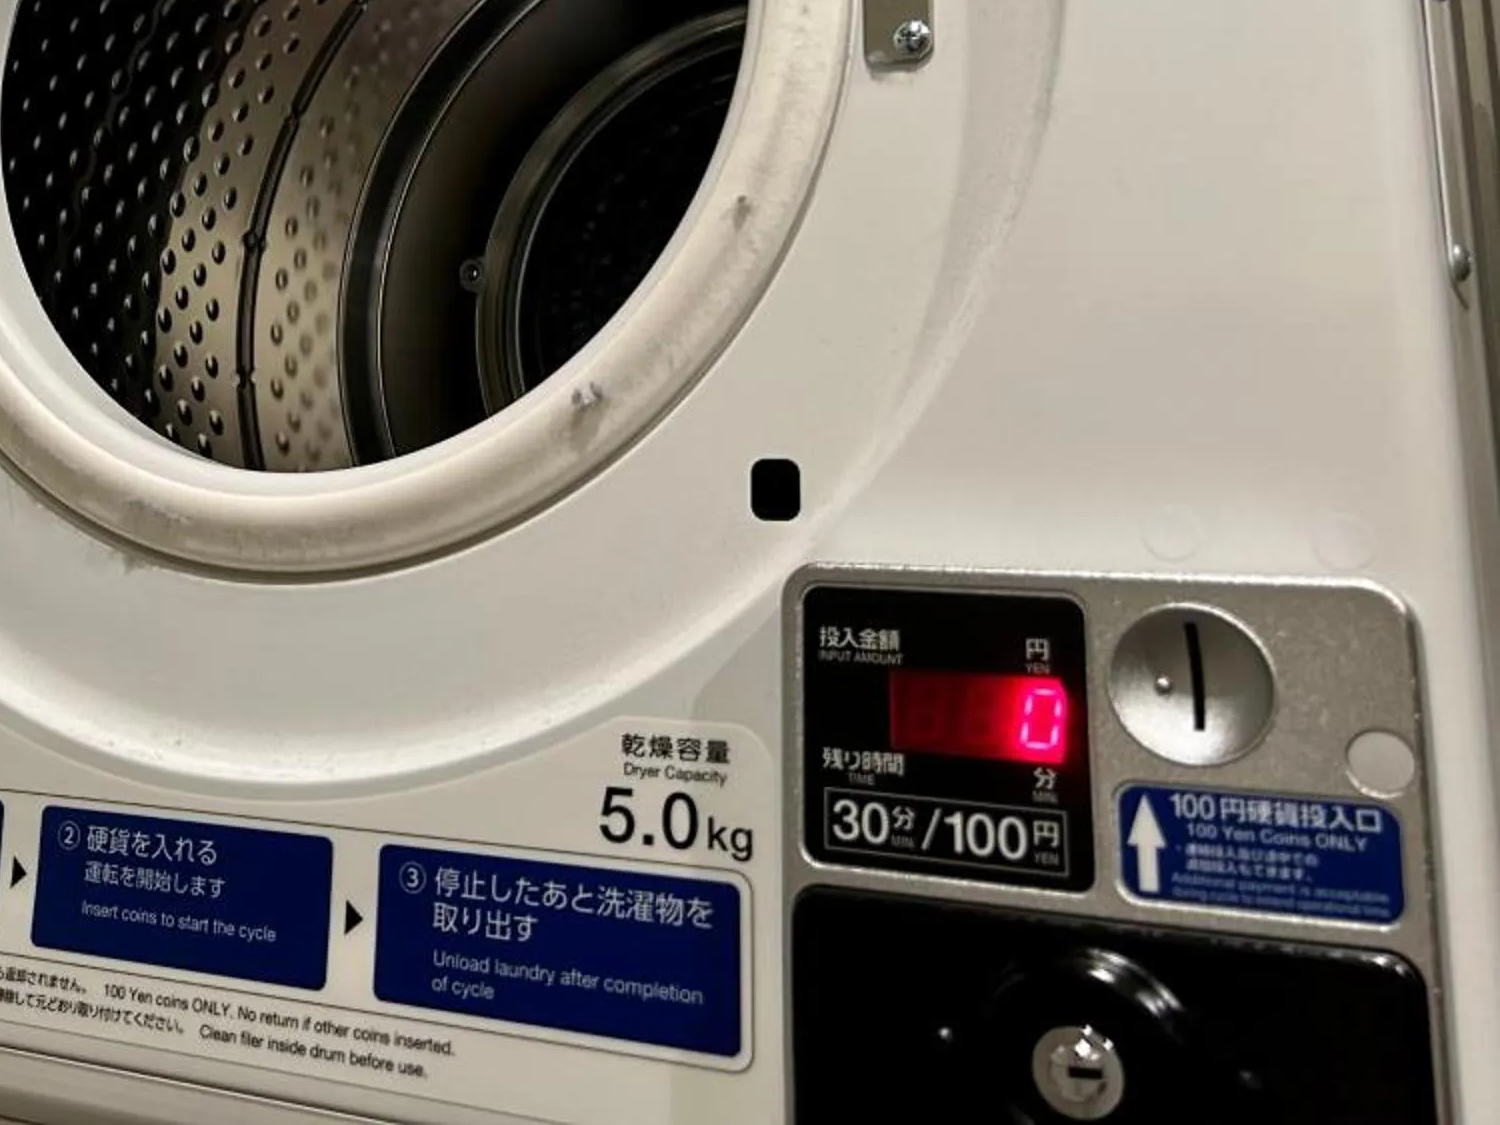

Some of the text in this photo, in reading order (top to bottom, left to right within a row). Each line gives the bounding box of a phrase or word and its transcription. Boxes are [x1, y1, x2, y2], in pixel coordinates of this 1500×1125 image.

[819, 626, 900, 652] 投入金額
[1025, 637, 1050, 661] 円
[819, 650, 903, 665] INPUT AMOUNT
[1024, 662, 1051, 674] YEN
[1020, 687, 1062, 750] 0
[621, 733, 731, 764] 乾燥容量
[822, 746, 905, 775] 残り時間
[623, 761, 728, 787] Dryer Capacity
[1032, 767, 1057, 790] 分
[87, 824, 218, 866] 硬貨を入れる
[1186, 823, 1368, 852] 100 Yen Coins ONLY
[83, 860, 227, 898] 運転を開始します
[435, 867, 714, 930] 停止したあと洗濯物を
[81, 899, 276, 942] Insert coins to start the cycle
[432, 901, 539, 942] 取り出す
[431, 976, 496, 1000] of cycle
[432, 949, 703, 1005] Unload laundry after completion
[104, 983, 126, 1000] 100
[129, 987, 152, 1005] Yen
[155, 993, 189, 1011] coins
[238, 1005, 257, 1022] No
[259, 1012, 299, 1031] return
[303, 1017, 312, 1032] if
[314, 1020, 349, 1038] other
[353, 1027, 391, 1046] coins
[394, 1034, 456, 1056] inserted.
[200, 1024, 237, 1044] Clean
[268, 1038, 306, 1056] inside
[310, 1045, 346, 1064] drum
[350, 1051, 395, 1073] before
[398, 1063, 427, 1079] use.
